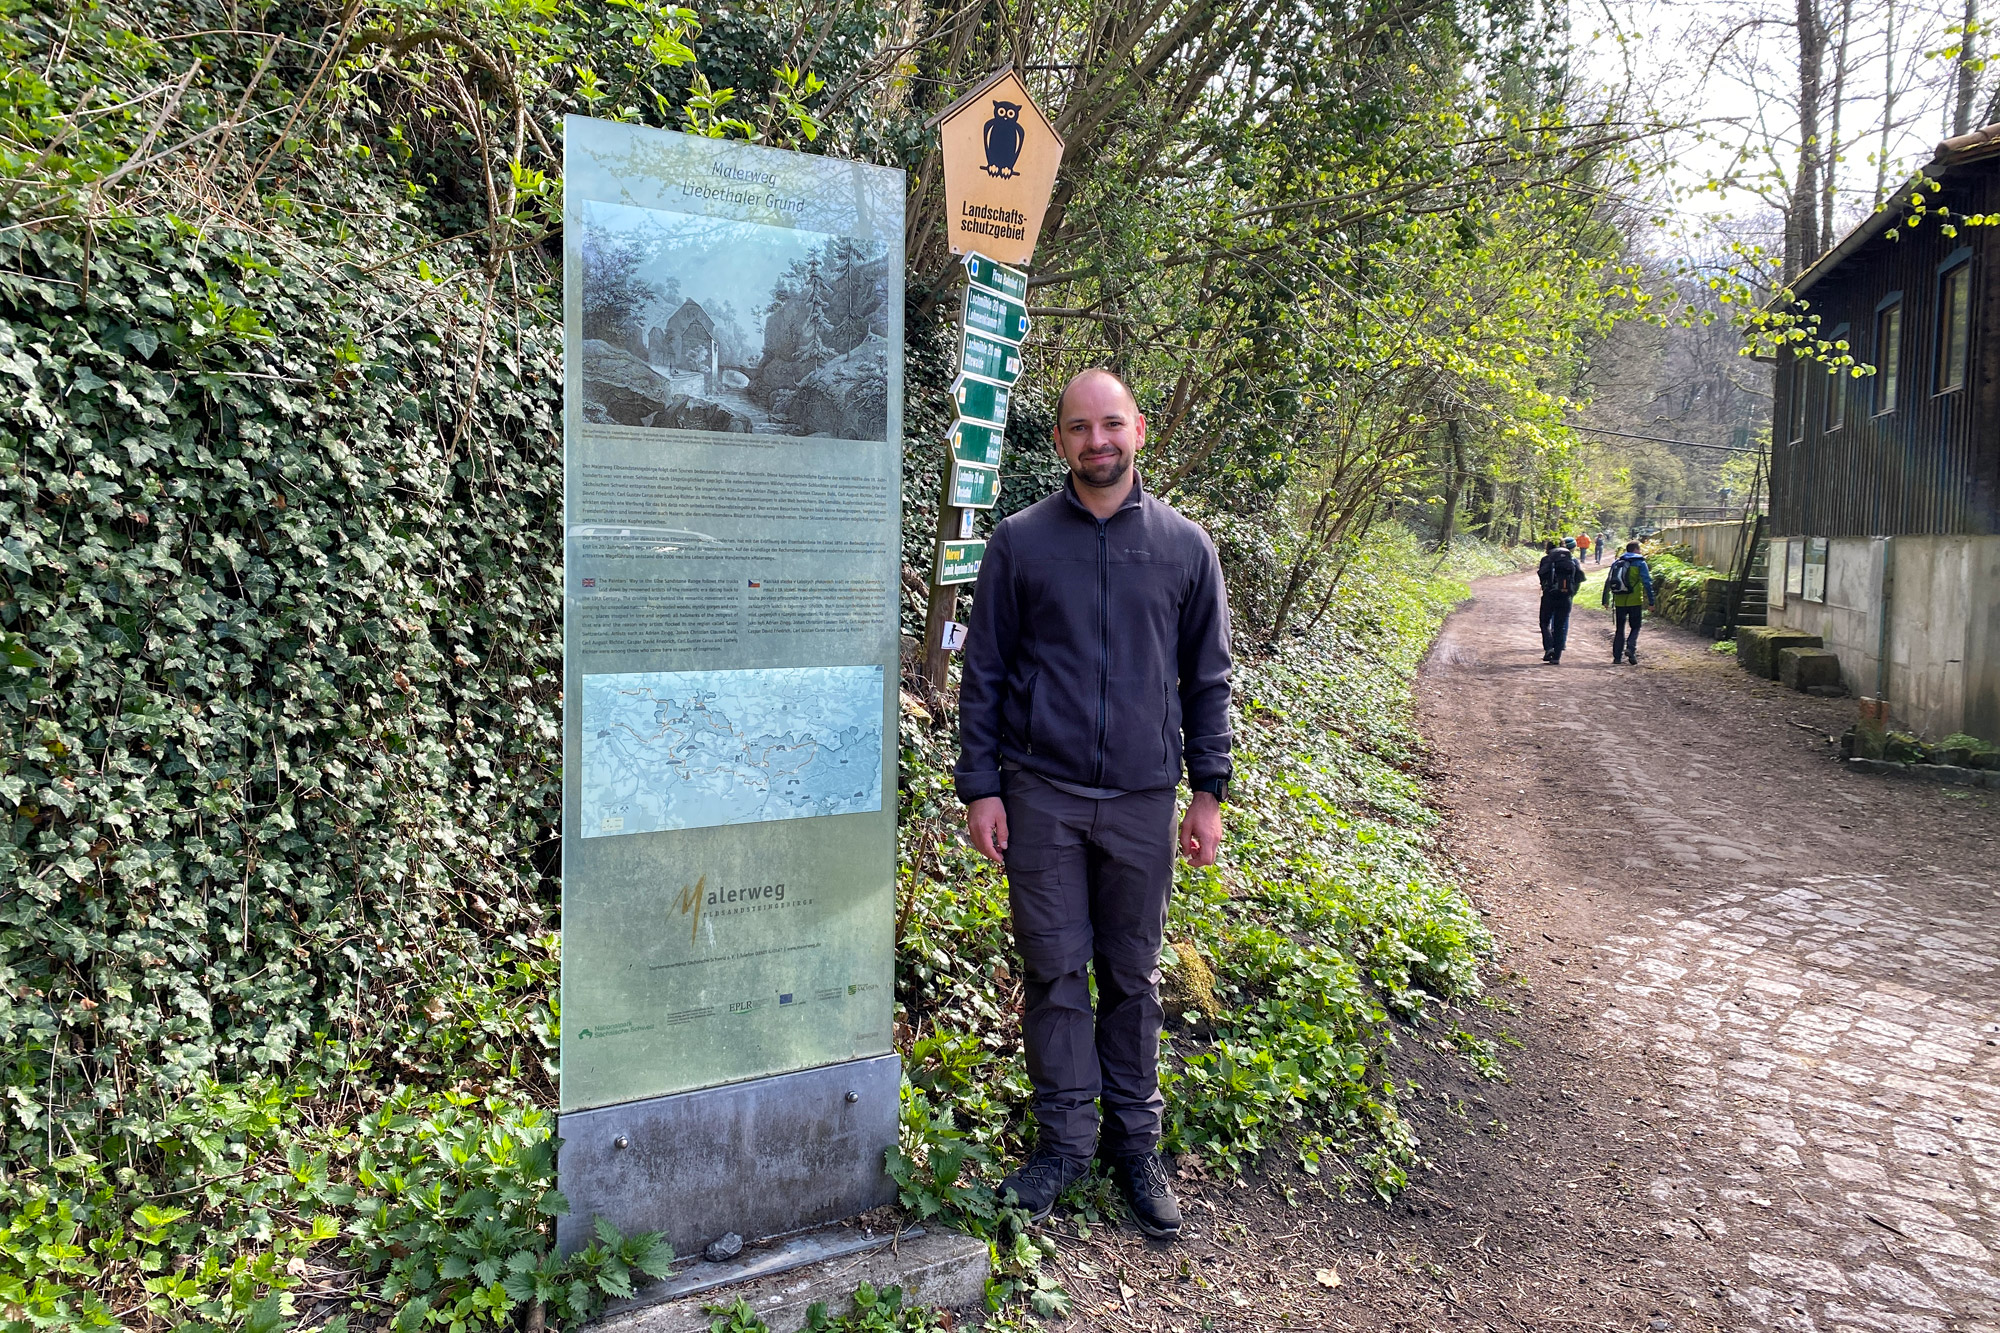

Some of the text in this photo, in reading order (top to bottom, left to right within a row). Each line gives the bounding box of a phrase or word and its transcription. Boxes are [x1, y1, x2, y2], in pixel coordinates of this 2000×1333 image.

[711, 161, 776, 188] Malerweg
[682, 180, 805, 212] Liebethaler Grund
[962, 200, 1028, 225] Landschafts-
[960, 217, 1025, 241] schutzgebiet
[664, 873, 786, 948] Malerweg
[729, 1000, 753, 1012] EPLR
[594, 1020, 632, 1031] Nationalpark
[594, 1028, 629, 1038] Sächsische
